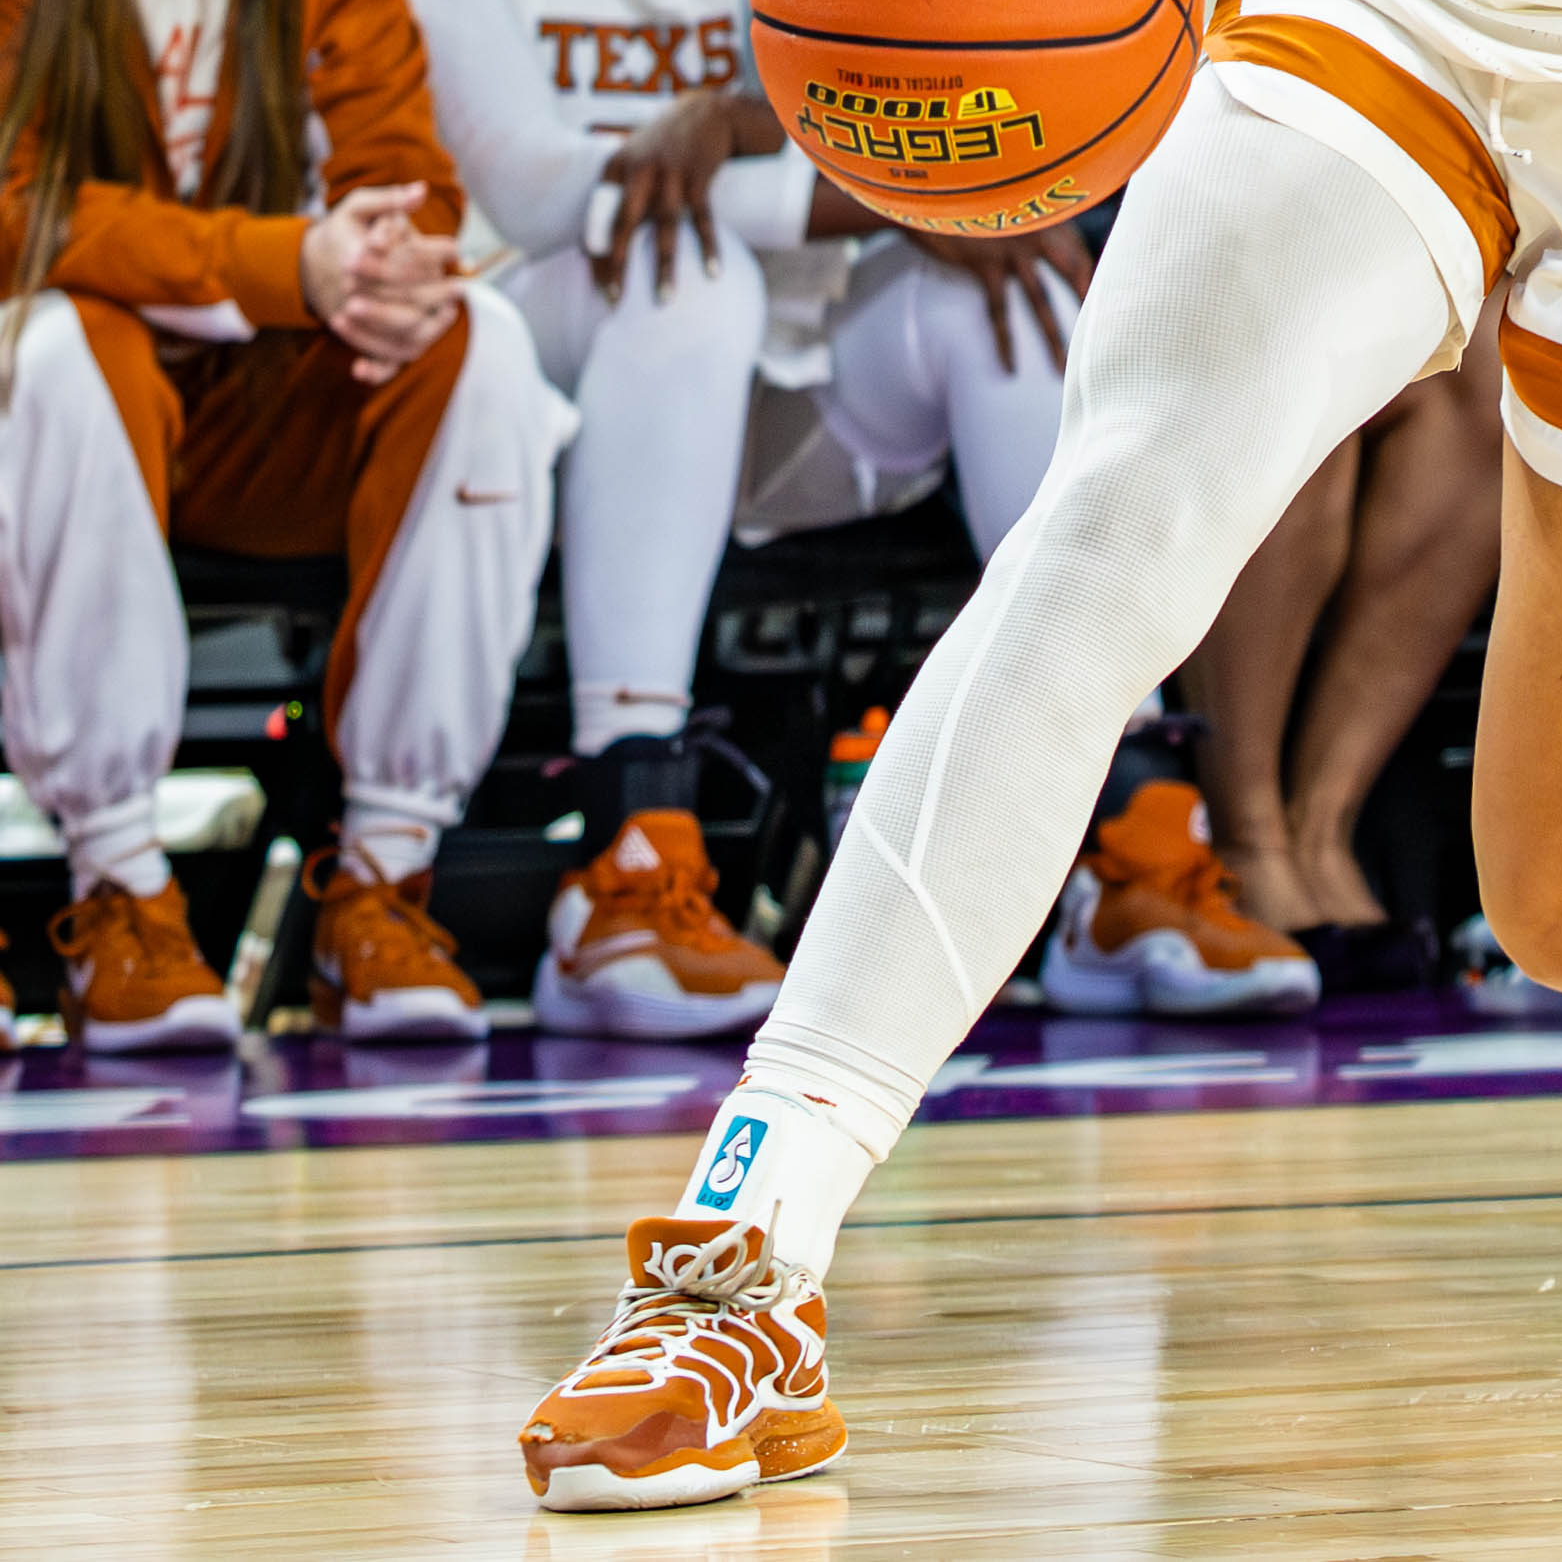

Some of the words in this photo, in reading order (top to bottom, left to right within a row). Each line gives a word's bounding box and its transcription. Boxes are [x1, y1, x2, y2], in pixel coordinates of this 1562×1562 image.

[867, 73, 900, 91] GAME
[904, 75, 963, 90] OFFICIAL
[806, 80, 950, 121] 1000
[797, 104, 1046, 163] LEGACY
